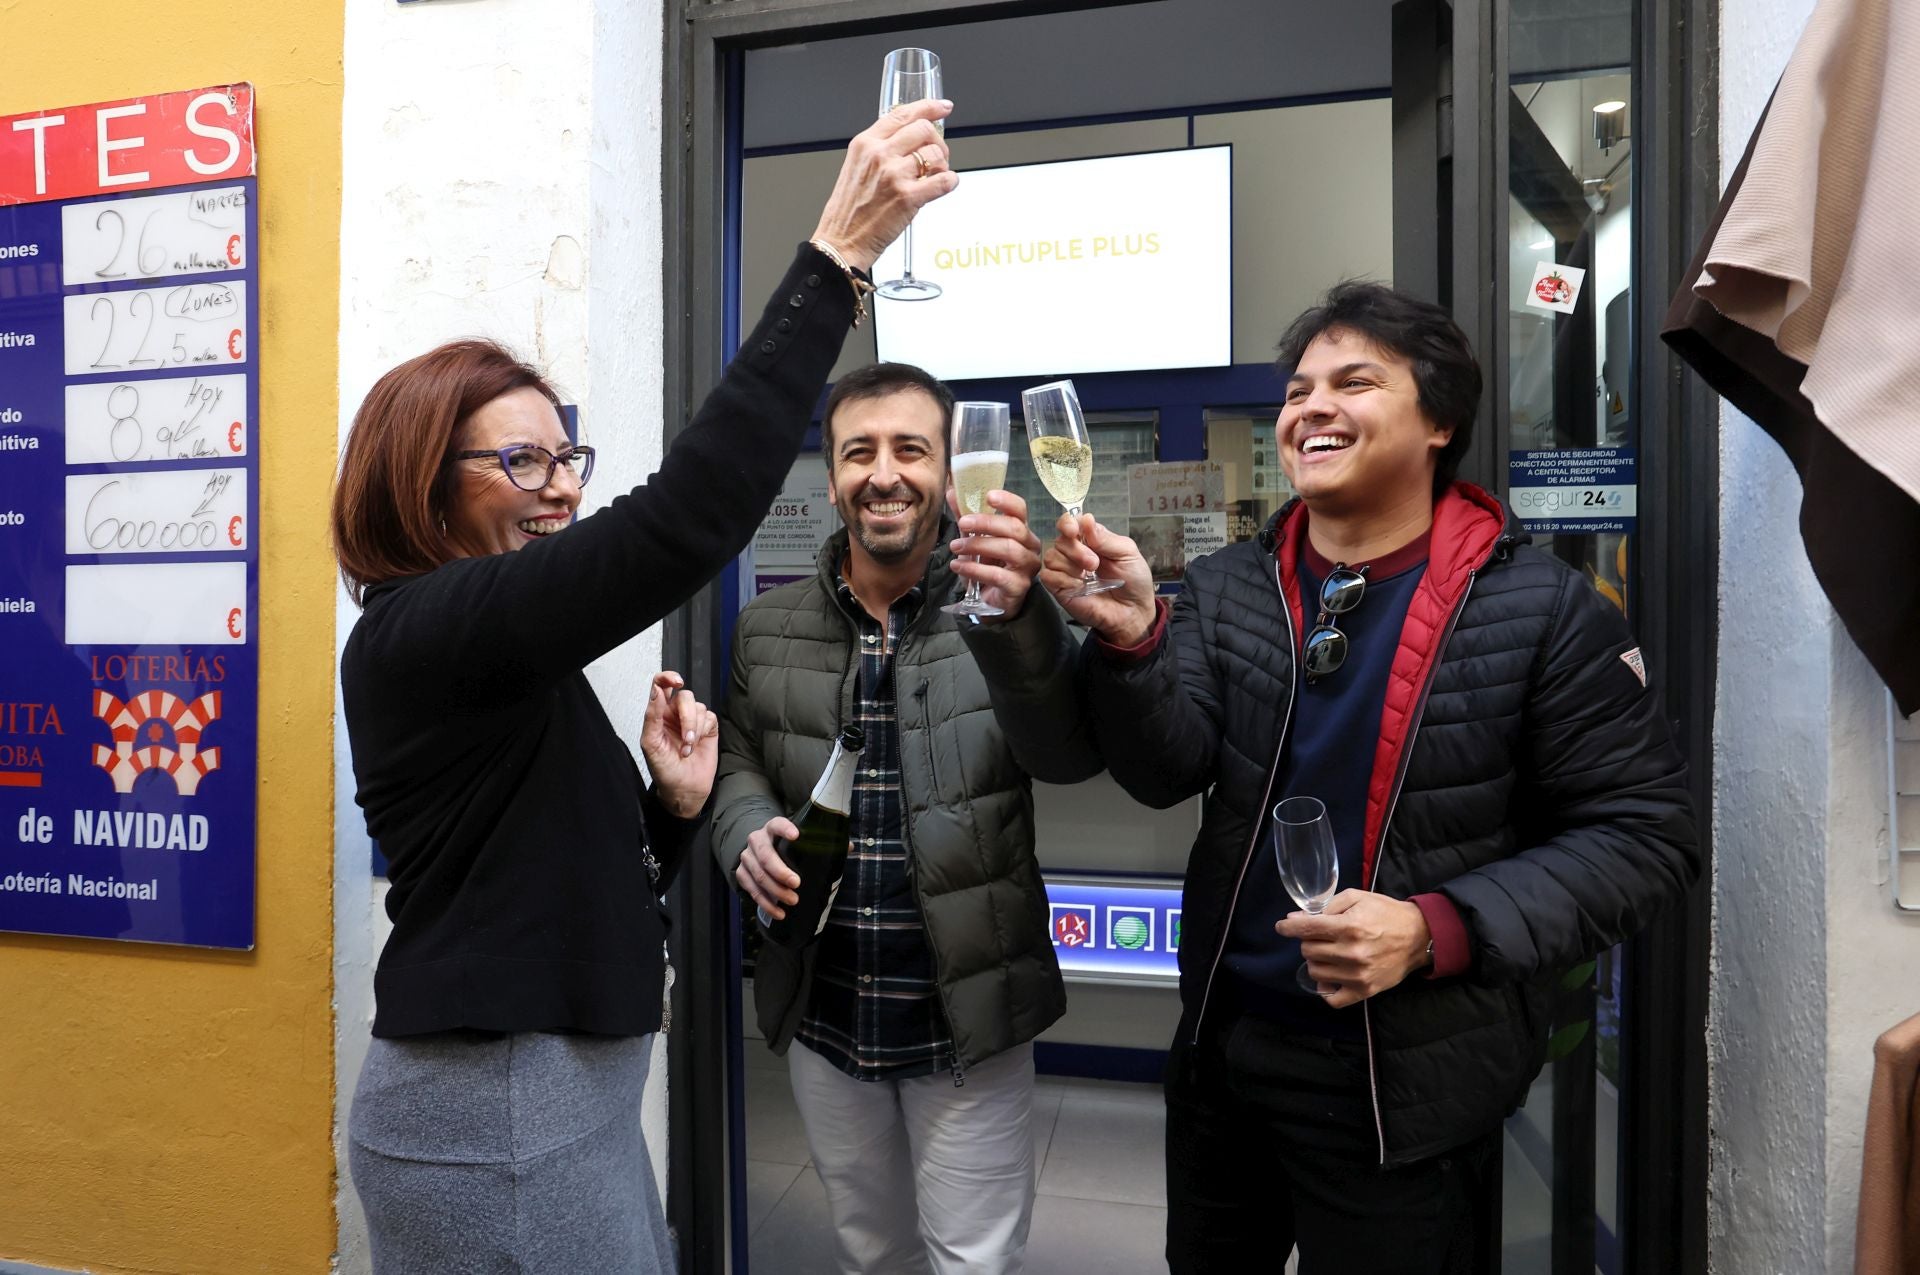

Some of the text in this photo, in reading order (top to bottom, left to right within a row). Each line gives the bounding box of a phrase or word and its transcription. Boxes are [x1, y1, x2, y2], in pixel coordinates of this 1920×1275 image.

[12, 92, 241, 195] TES
[0, 244, 39, 259] ones
[95, 208, 167, 278] 26
[226, 234, 241, 266] €
[934, 232, 1161, 271] QUÍNTUPLE PLUS
[227, 328, 242, 360] €
[0, 407, 23, 424] do
[0, 434, 39, 450] itiva
[227, 421, 242, 453] €
[1510, 458, 1635, 468] CONECTADO PERMANENTEMENTE
[1527, 451, 1559, 459] SISTEMA
[1572, 450, 1617, 458] SEGURIDAD
[1534, 468, 1569, 476] CENTRAL
[1570, 467, 1617, 475] RECEPTORA
[1547, 476, 1596, 484] DE ALARMAS
[768, 504, 809, 516] .035 €
[1146, 493, 1206, 512] 13143
[227, 515, 242, 547] €
[1184, 535, 1224, 544] reconquista
[1522, 523, 1532, 531] 02
[1562, 521, 1624, 533] www.segur24.es
[226, 607, 242, 639] €
[91, 650, 226, 682] LOTERÍAS
[0, 703, 65, 735] ITA
[18, 807, 209, 851] de NAVIDAD
[68, 873, 157, 901] Nacional
